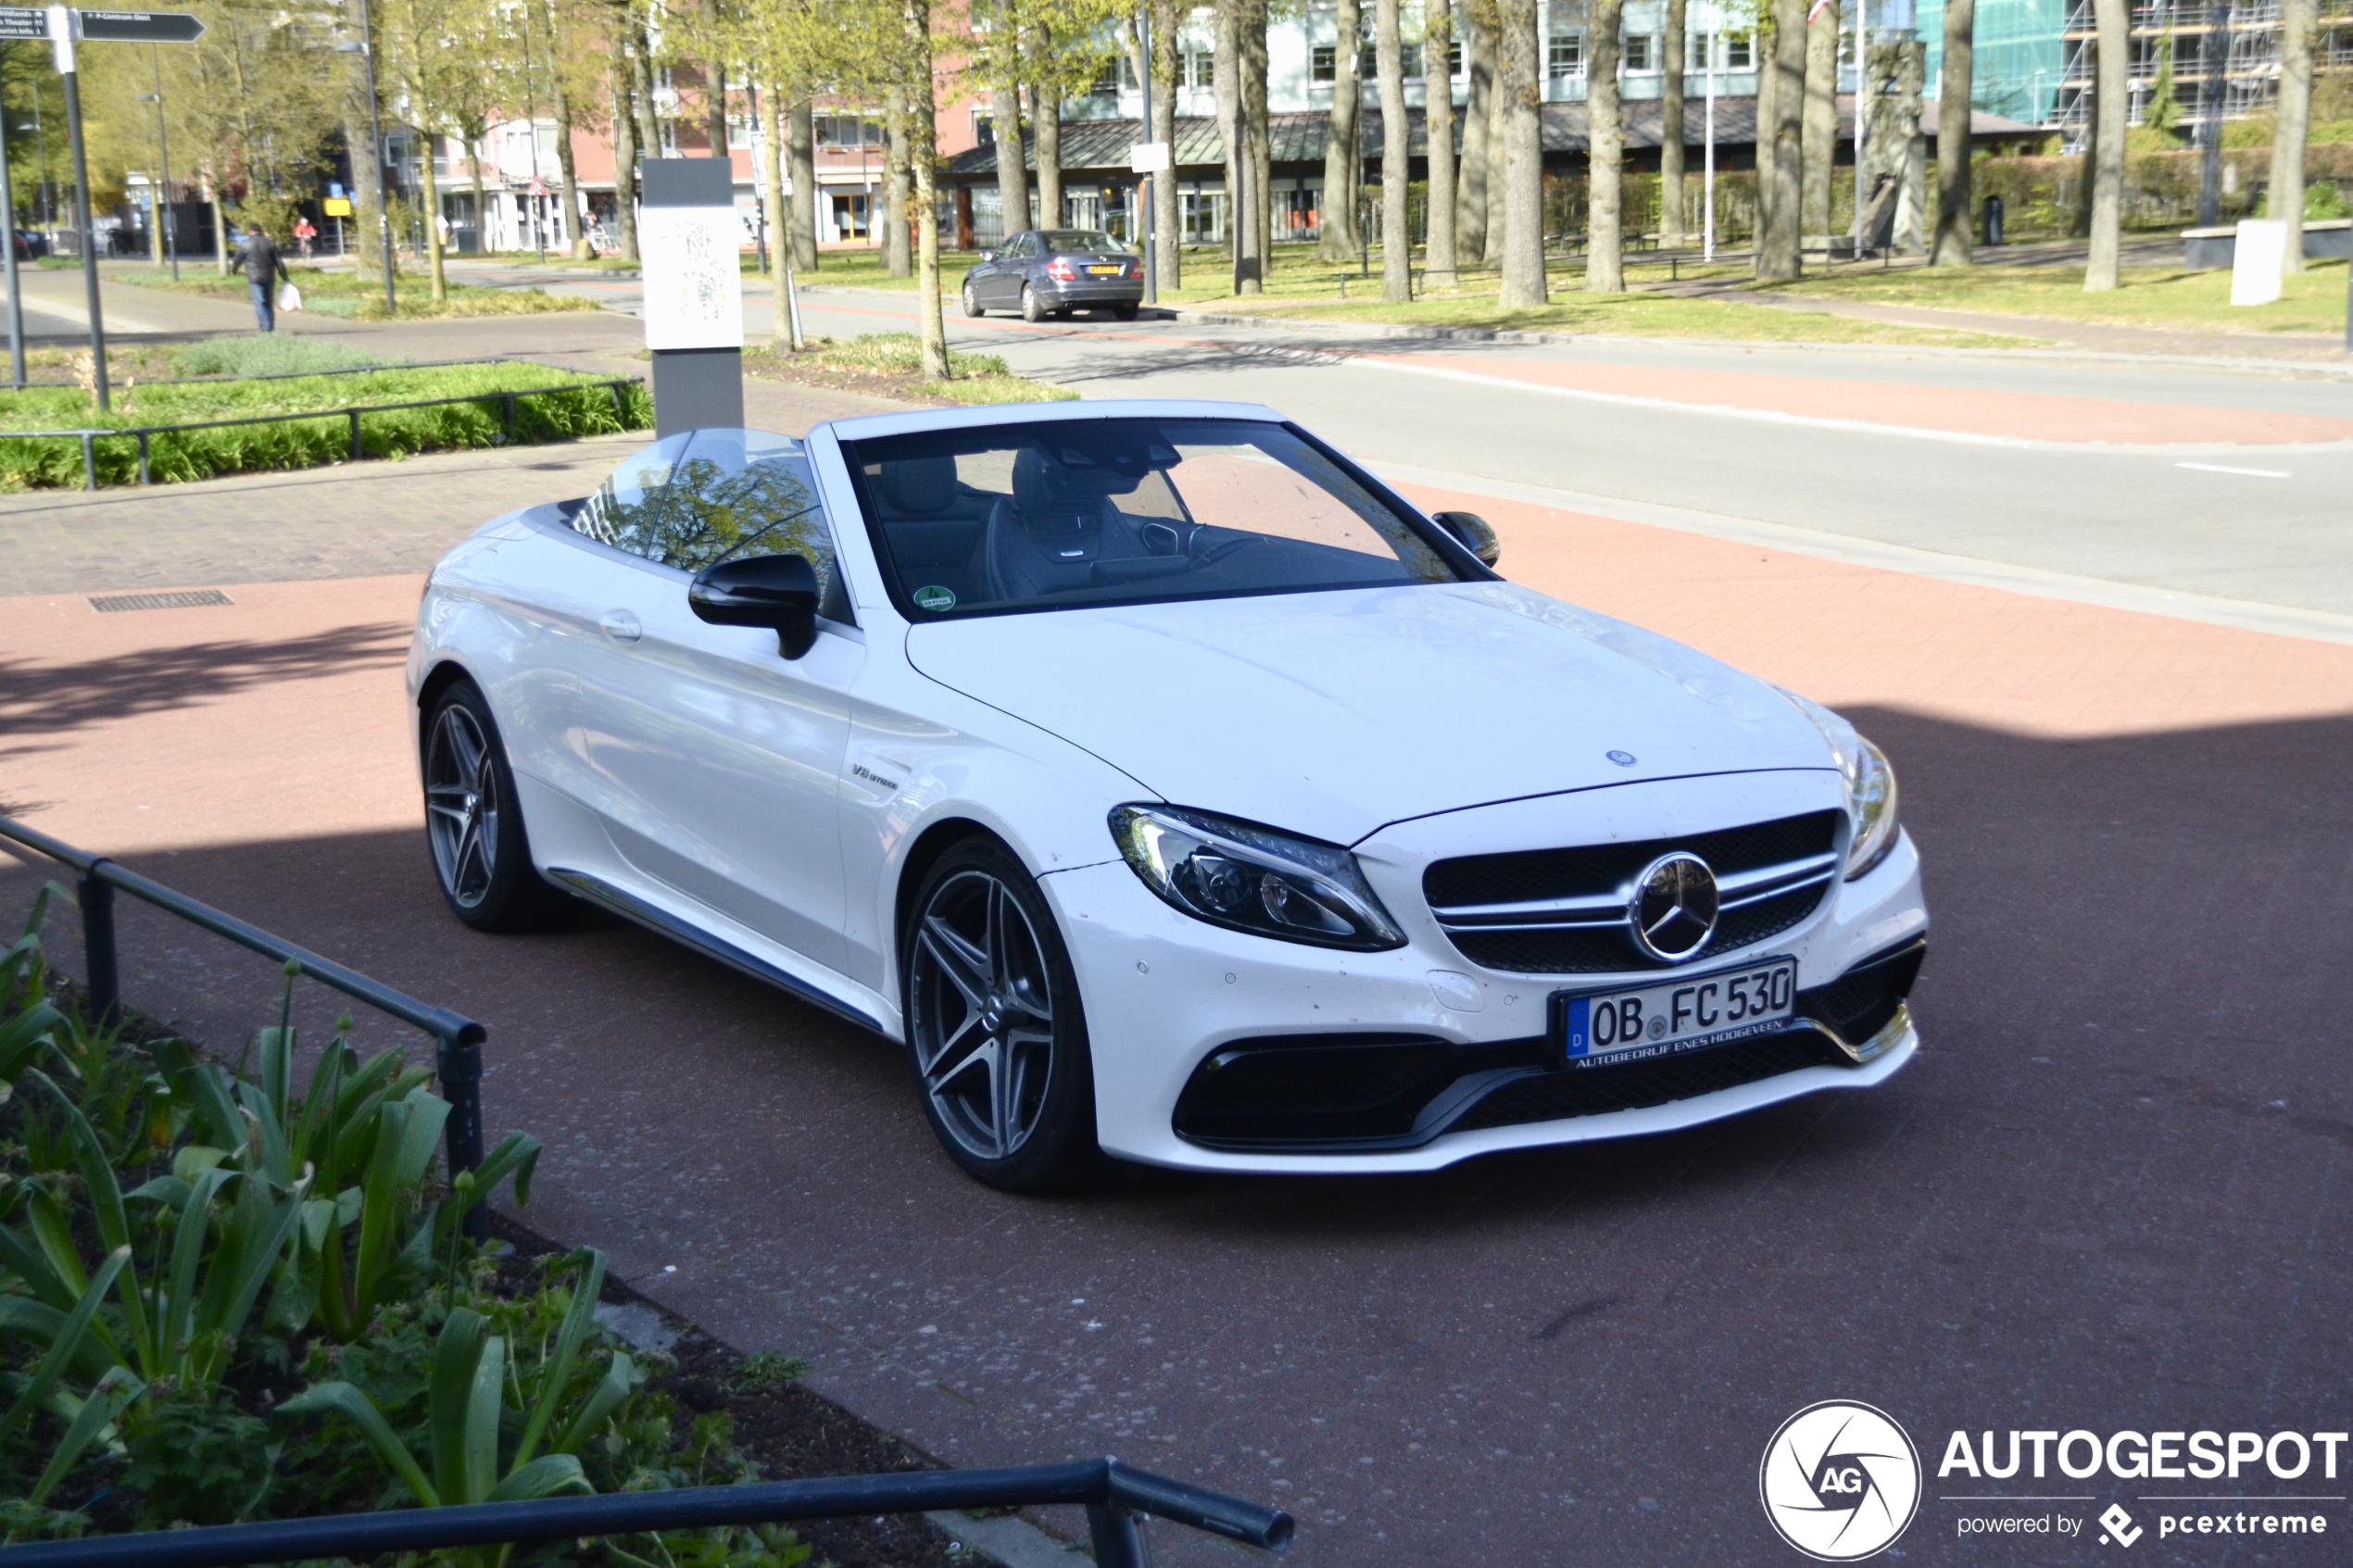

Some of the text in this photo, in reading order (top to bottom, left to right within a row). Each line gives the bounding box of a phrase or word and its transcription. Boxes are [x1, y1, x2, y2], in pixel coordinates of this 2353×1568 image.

[852, 763, 870, 779] V8
[1592, 966, 1790, 1046] OB FC 530
[1572, 1034, 1582, 1047] D
[1674, 1037, 1708, 1052] ENES
[1711, 1020, 1783, 1044] HOOGEVEEN
